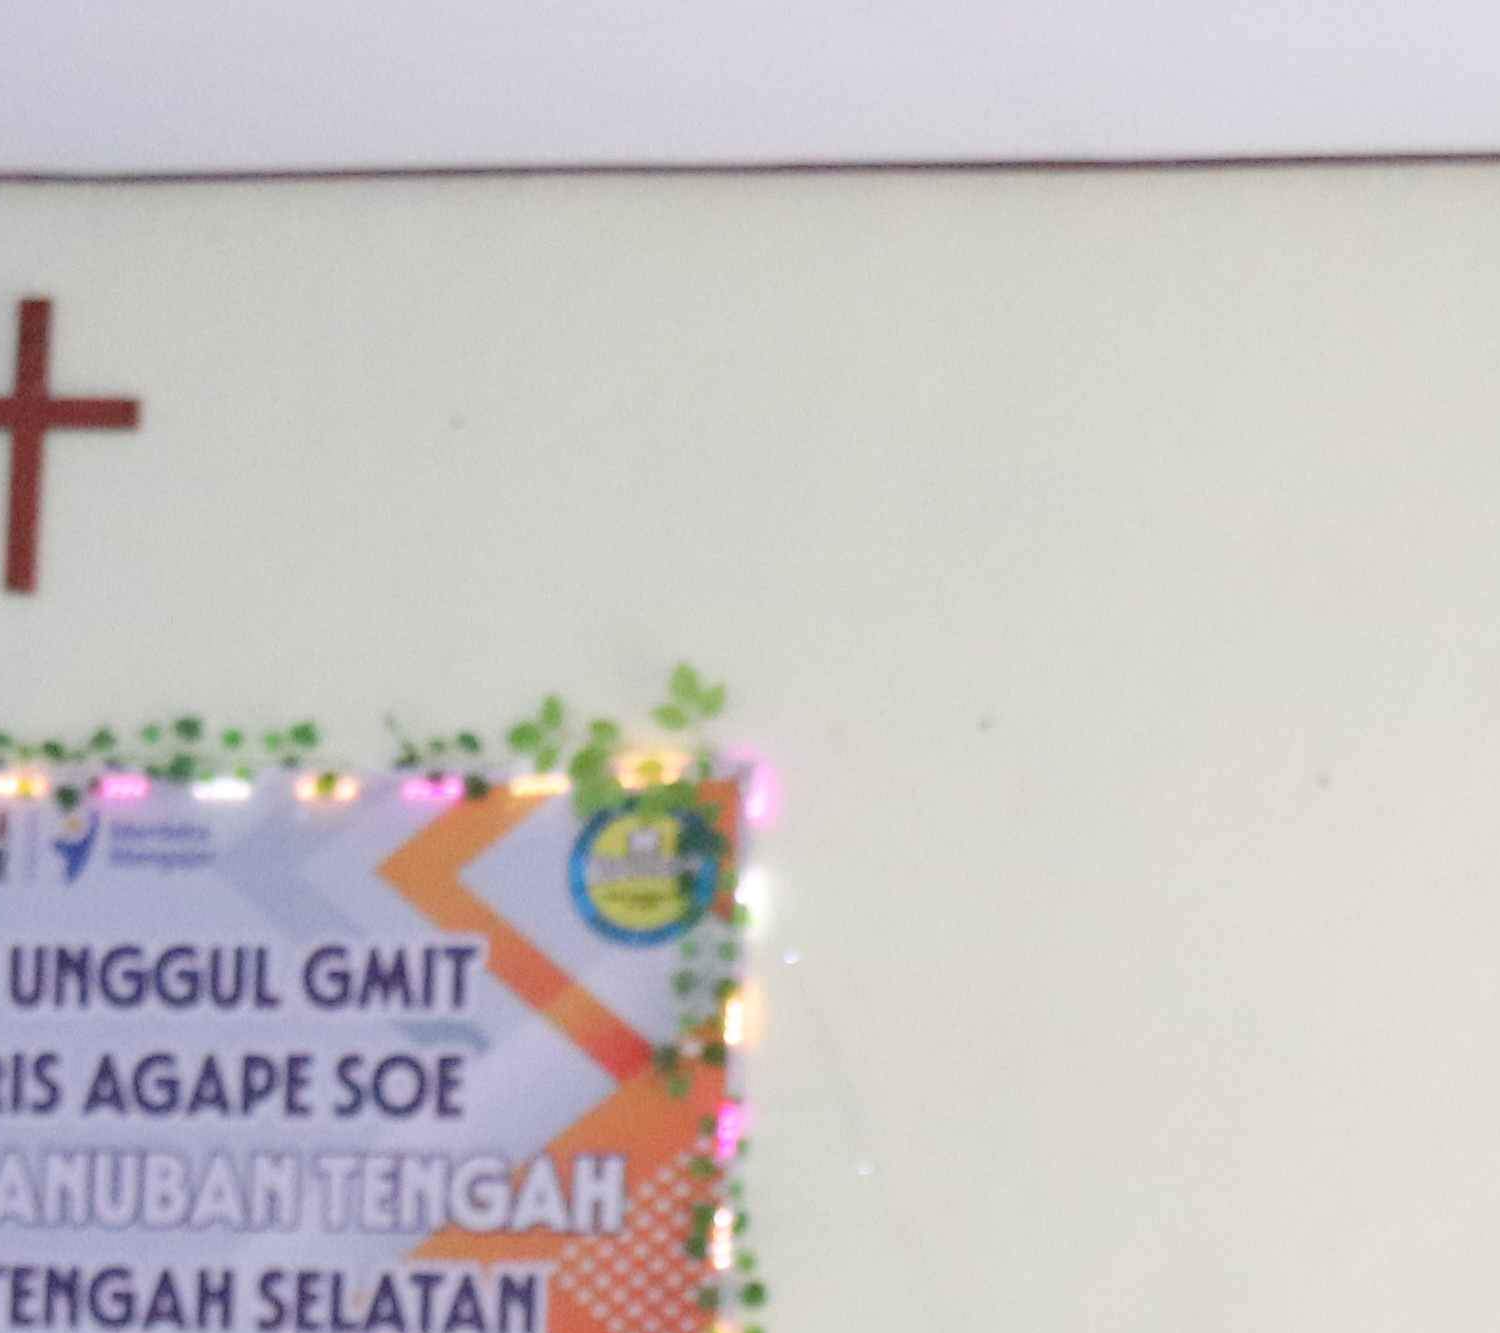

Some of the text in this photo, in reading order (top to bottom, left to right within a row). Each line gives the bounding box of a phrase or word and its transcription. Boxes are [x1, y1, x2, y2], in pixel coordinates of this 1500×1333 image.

[9, 945, 284, 1008] UNGGUL
[303, 946, 477, 1008] GMIT
[83, 1053, 314, 1116] AGAPE
[333, 1054, 466, 1117] SOE
[315, 1150, 632, 1236] TENGAH
